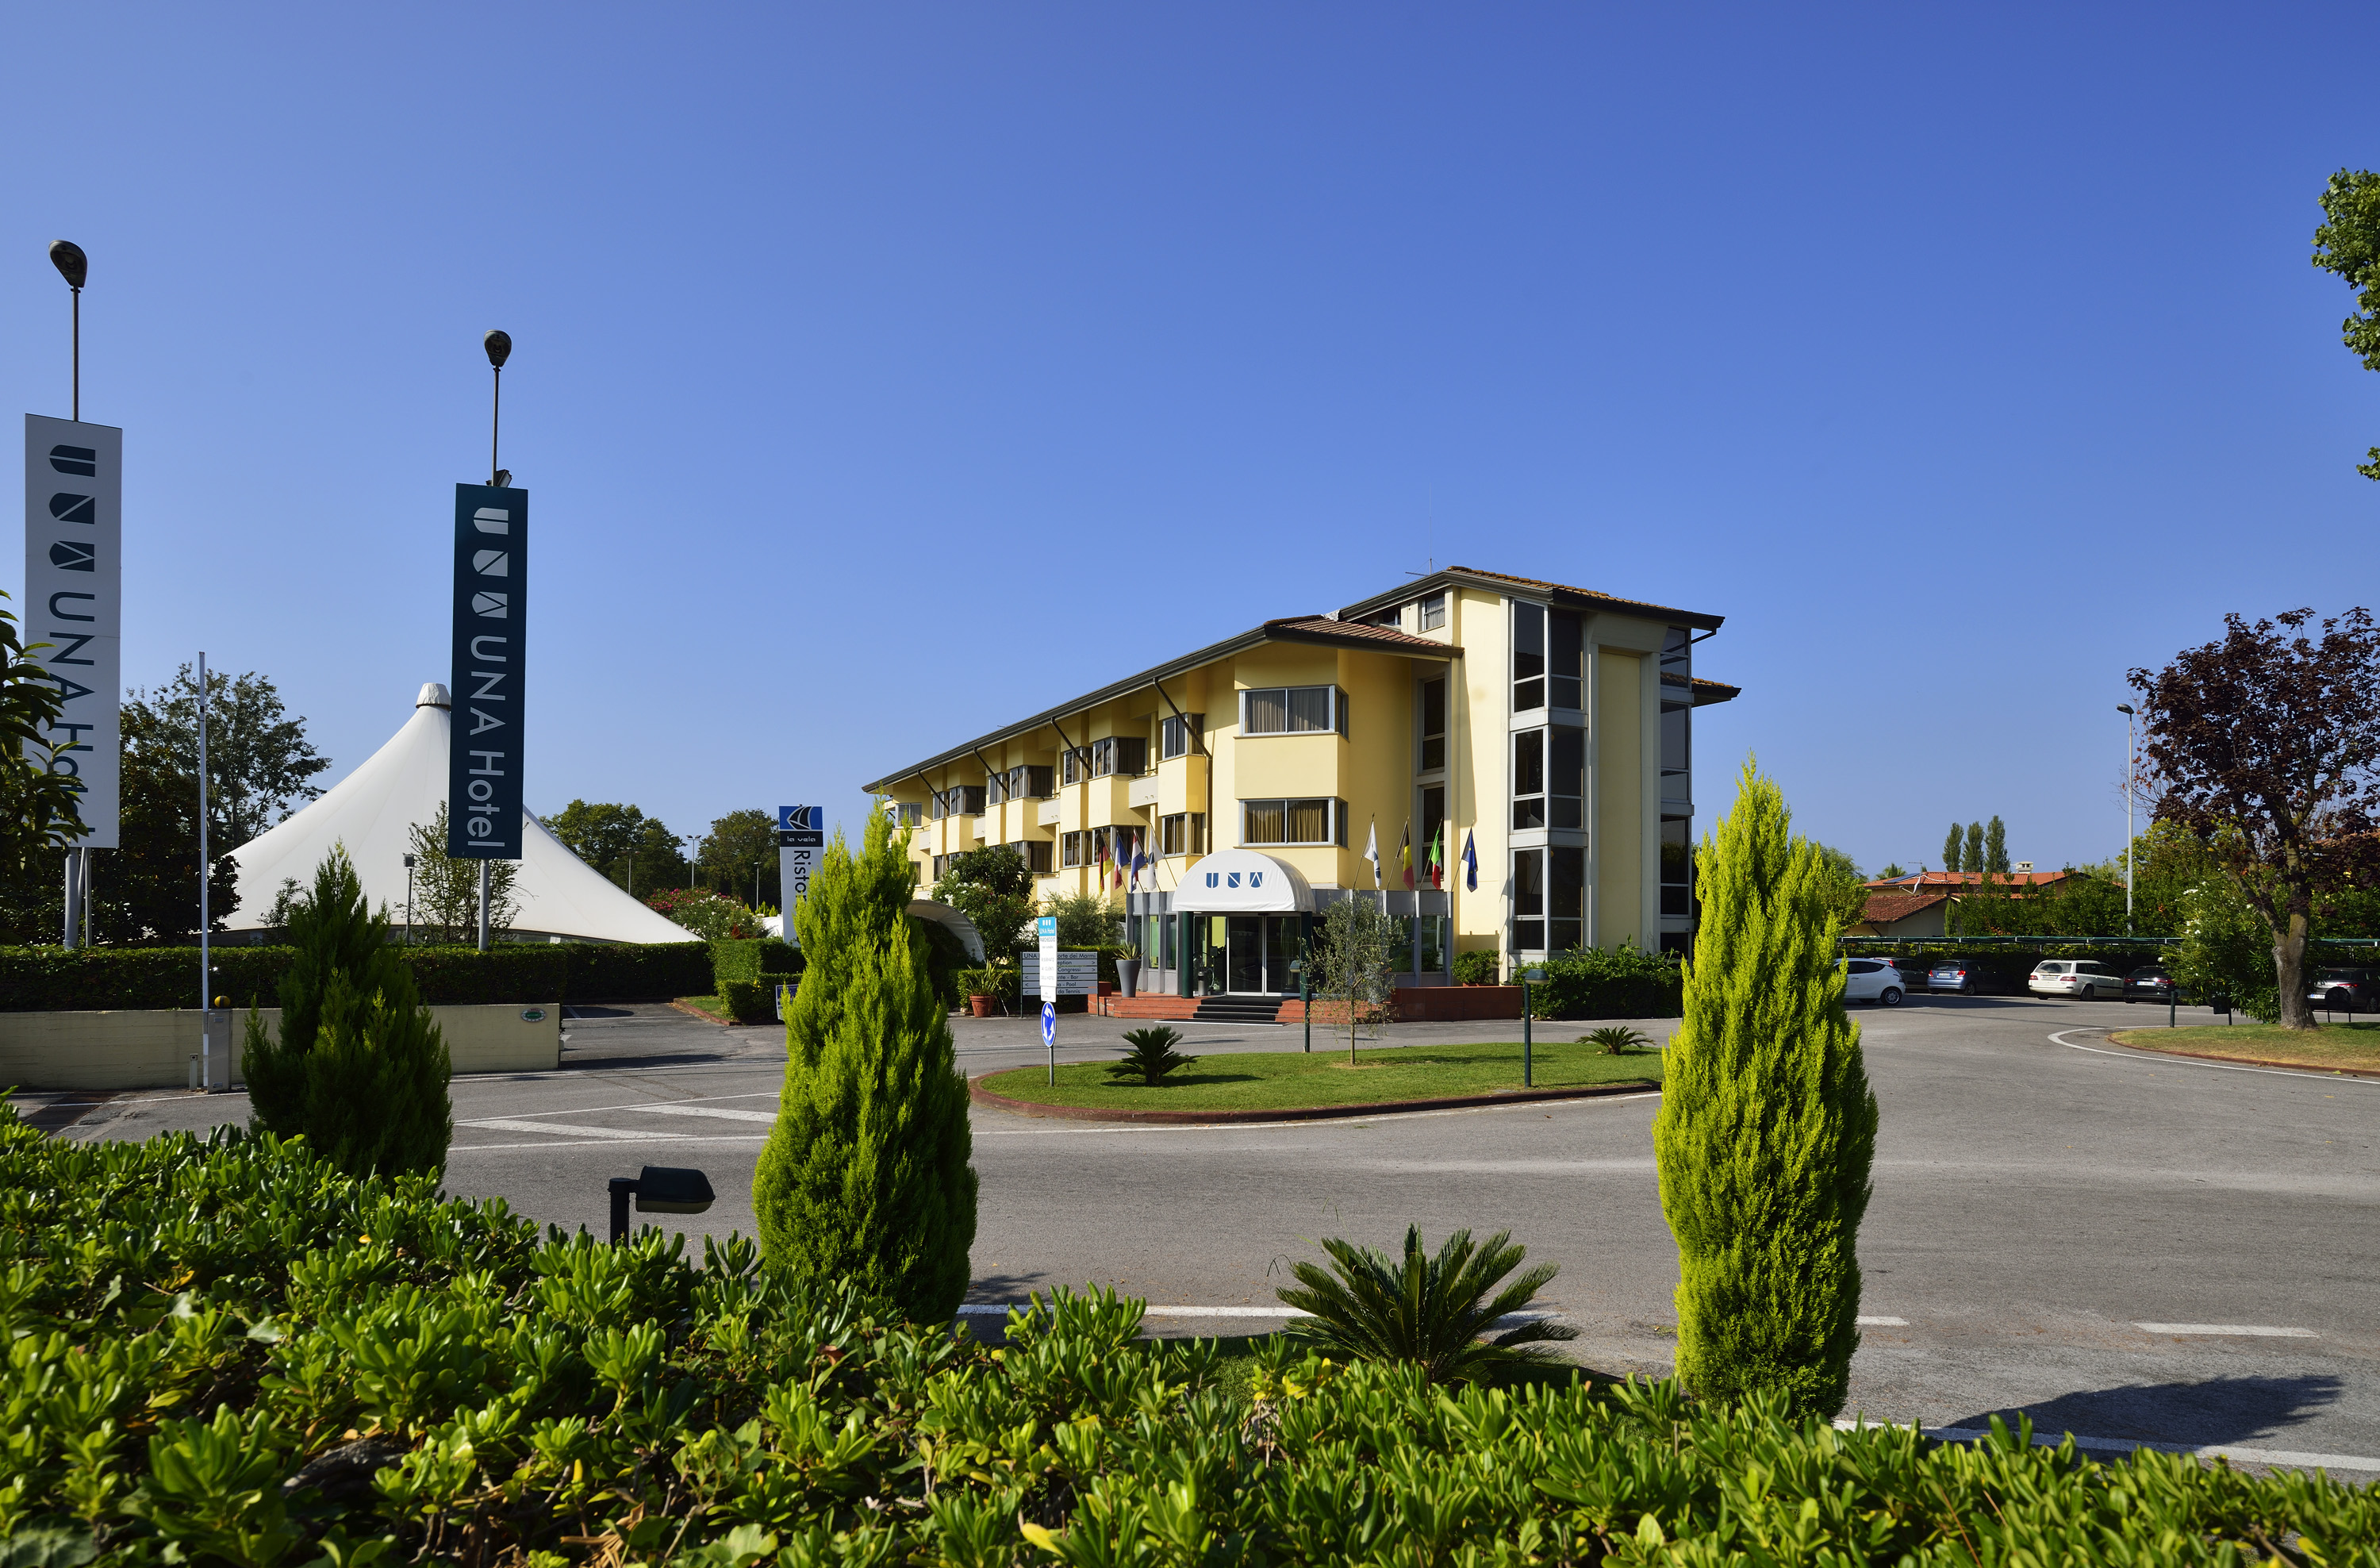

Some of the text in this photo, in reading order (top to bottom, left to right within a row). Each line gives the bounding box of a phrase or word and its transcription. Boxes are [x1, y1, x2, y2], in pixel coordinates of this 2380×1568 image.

[48, 591, 96, 705] UNA
[469, 635, 508, 736] UNA
[48, 722, 96, 833] Hot
[466, 750, 505, 847] Hotel
[793, 850, 811, 909] Ristor
